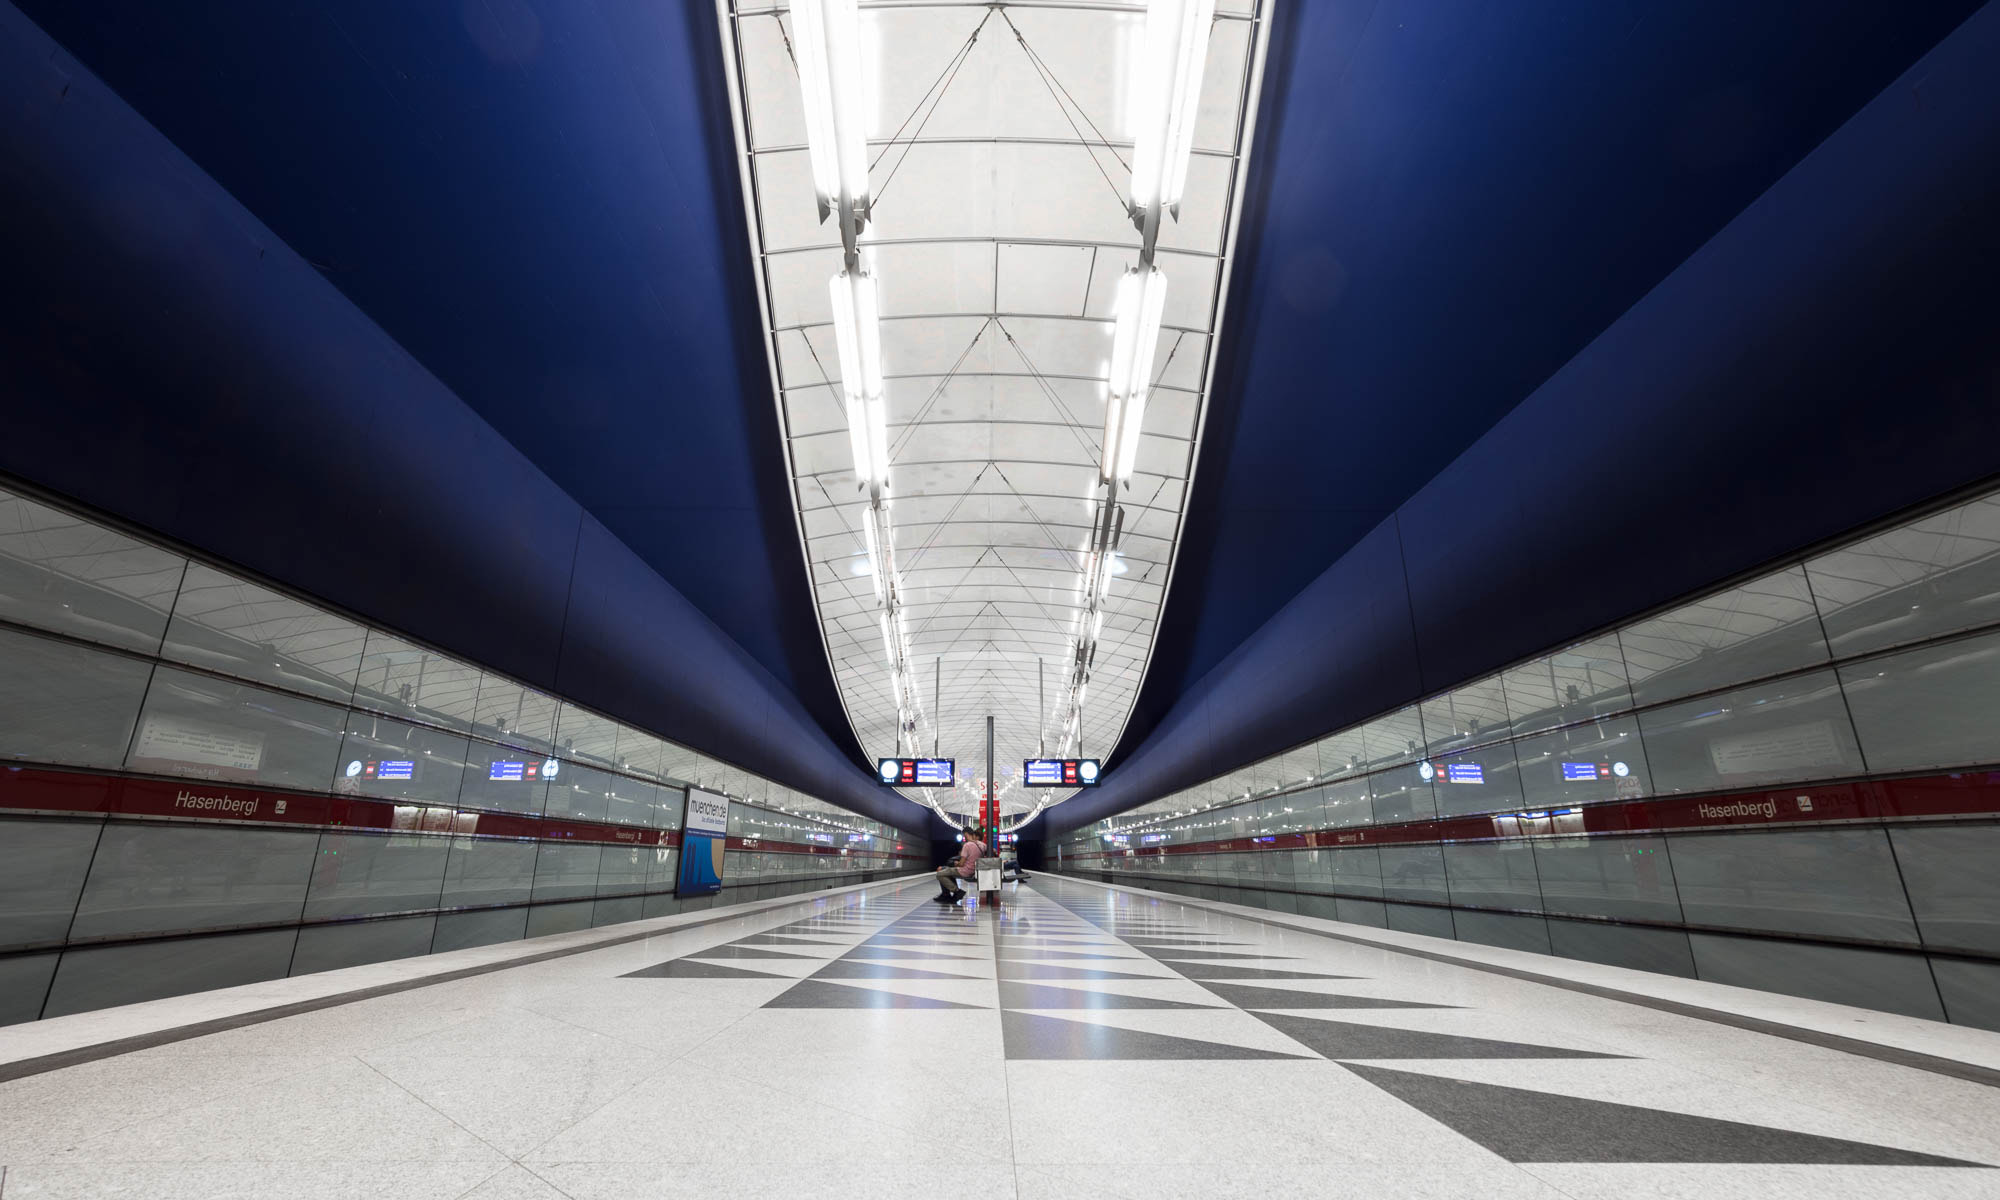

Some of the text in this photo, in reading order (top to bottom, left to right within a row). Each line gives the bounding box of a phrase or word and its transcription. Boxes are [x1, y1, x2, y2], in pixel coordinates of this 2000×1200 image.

[980, 781, 999, 791] SS
[175, 790, 259, 816] Hasenbergl
[1699, 798, 1777, 818] Hasenbergl
